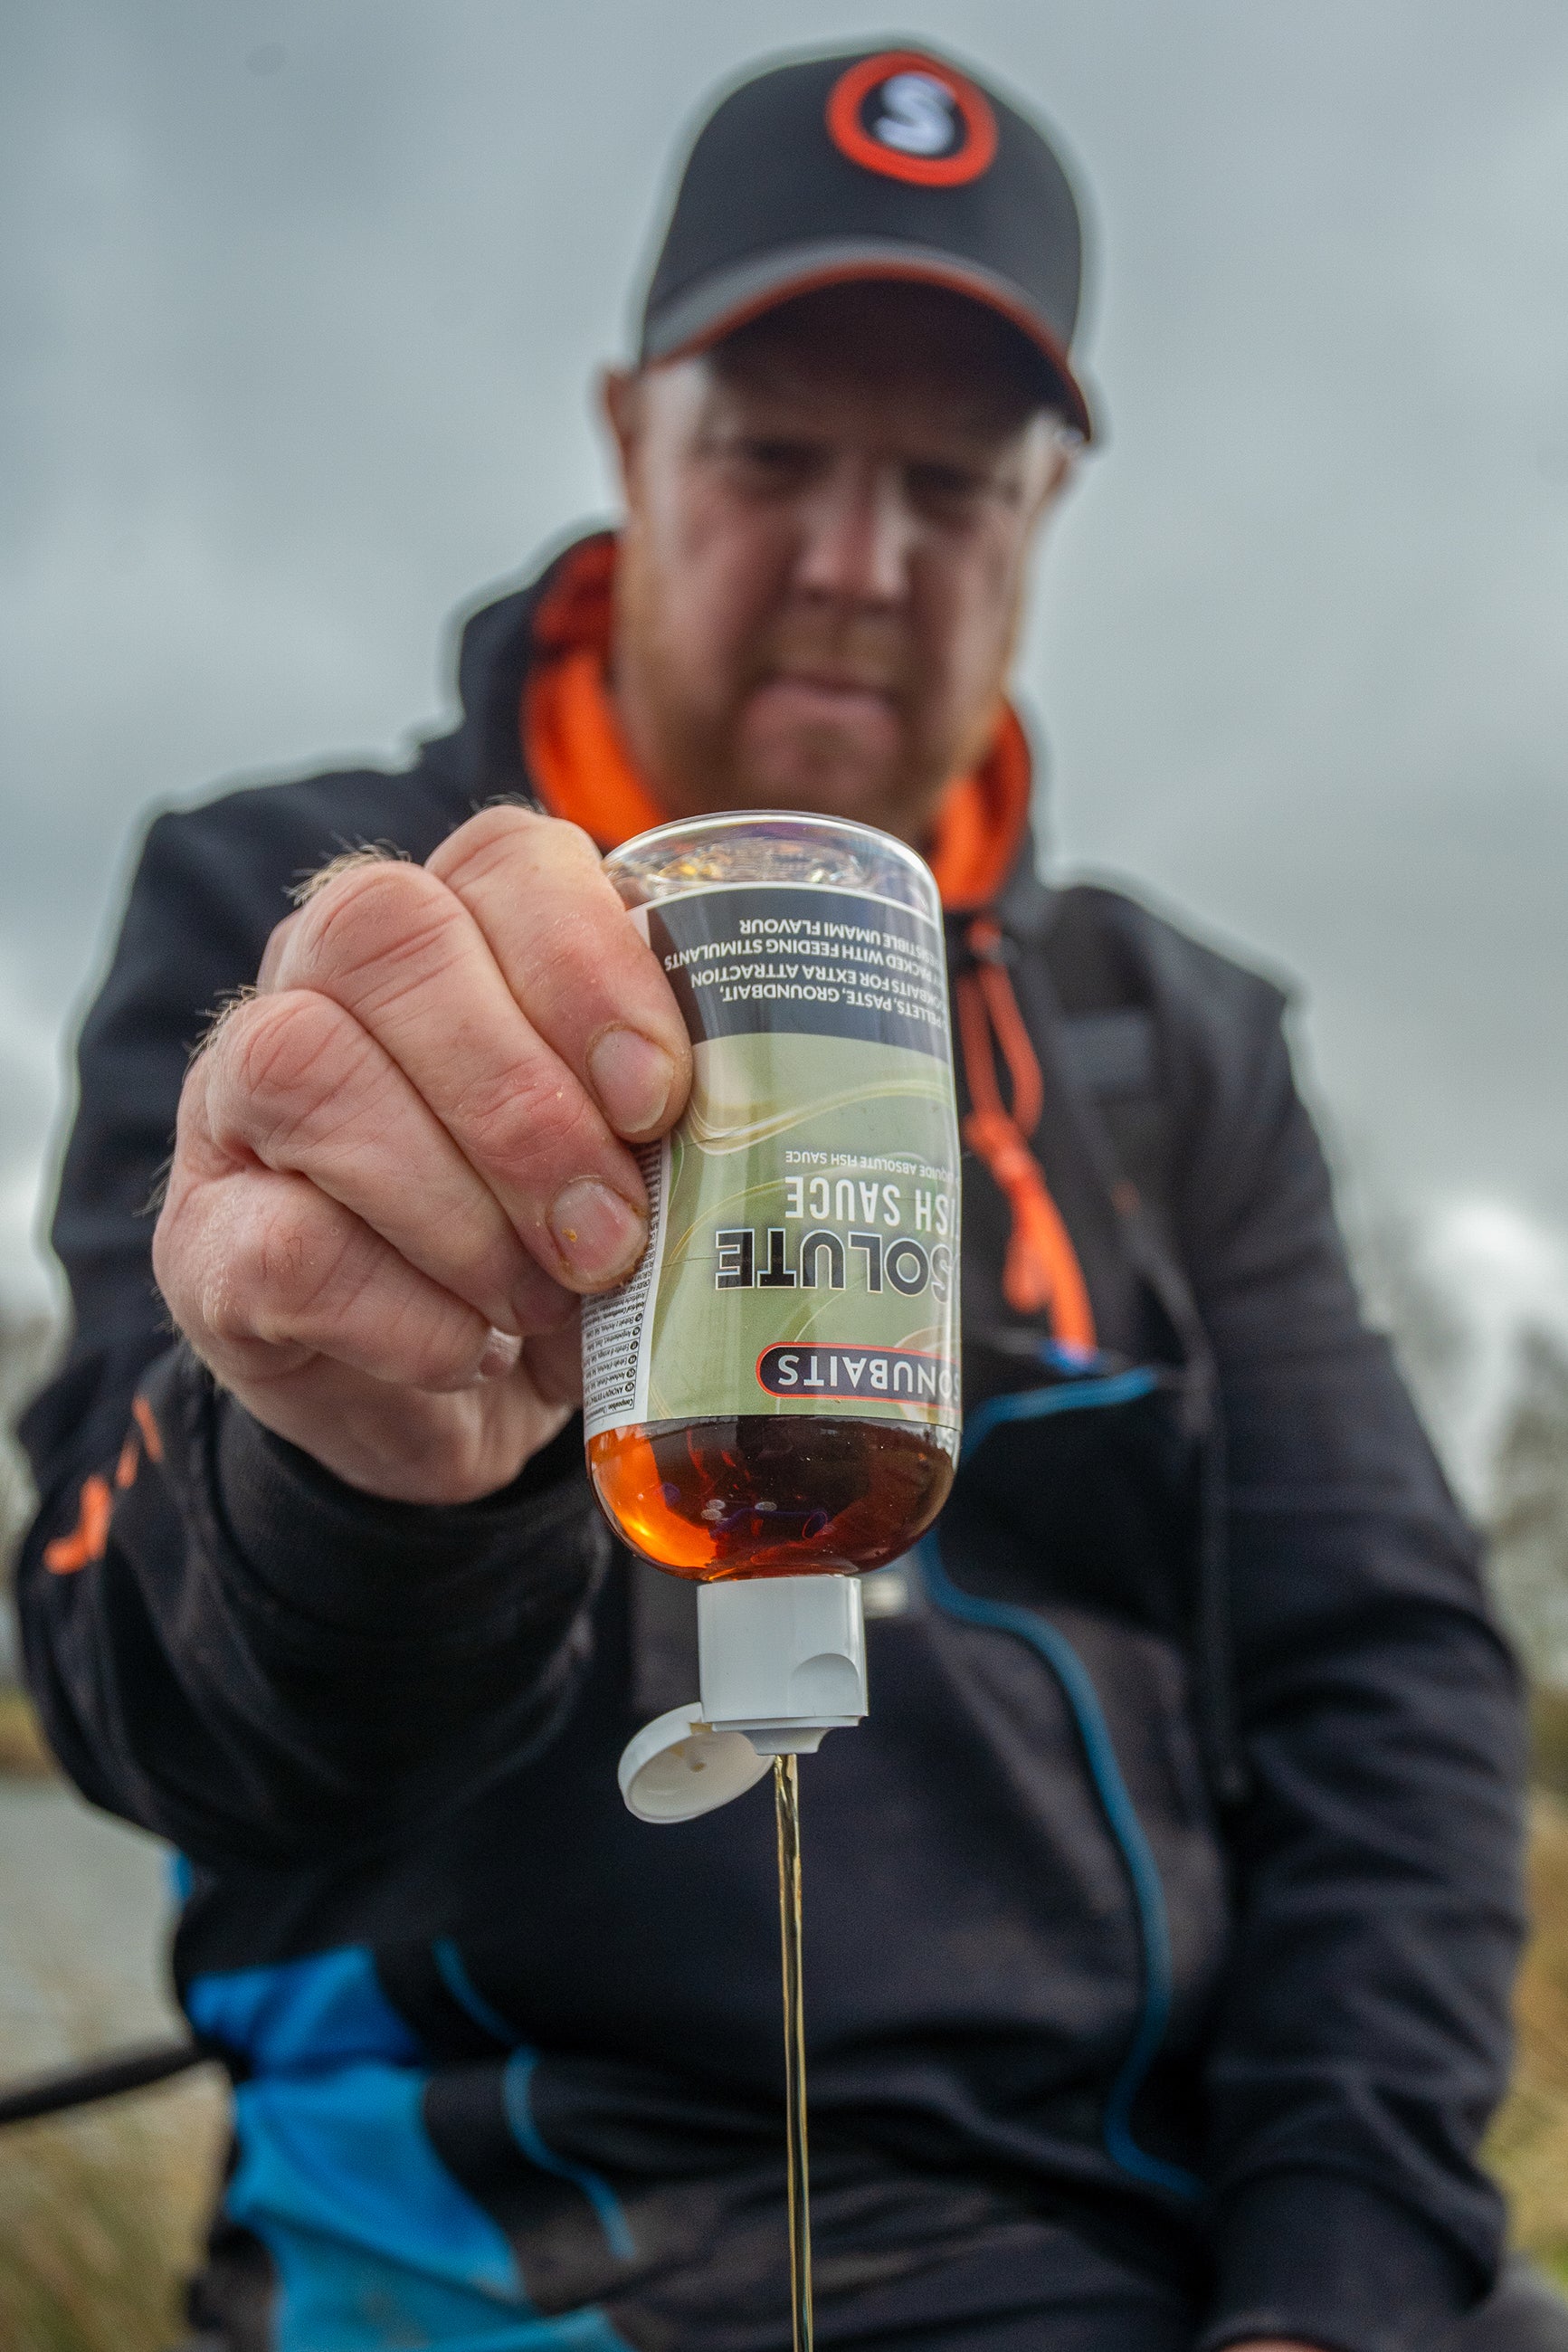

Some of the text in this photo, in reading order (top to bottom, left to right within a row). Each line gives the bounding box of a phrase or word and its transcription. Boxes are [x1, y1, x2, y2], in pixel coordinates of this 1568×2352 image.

[738, 918, 821, 936] FLAVOUR
[824, 921, 881, 947] UMAMI
[664, 938, 763, 971] STIMULANTS
[765, 938, 840, 958] FEEDING
[841, 945, 883, 967] WITH
[690, 963, 799, 988] ATTRACTION
[802, 965, 856, 985] EXTRA
[886, 954, 932, 983] PACKED
[719, 983, 840, 1002] GROUNDBAIT,
[860, 972, 889, 991] FOR
[841, 987, 892, 1011] PASTE,
[891, 978, 941, 1010] OKBAITS
[785, 1151, 827, 1164] SAUCE
[831, 1153, 858, 1166] FISH
[860, 1156, 917, 1176] ABSOLUTE
[784, 1176, 955, 1239] ISH SAUCE
[715, 1227, 952, 1304] SOLUTE
[778, 1354, 960, 1401] SONUBAITS
